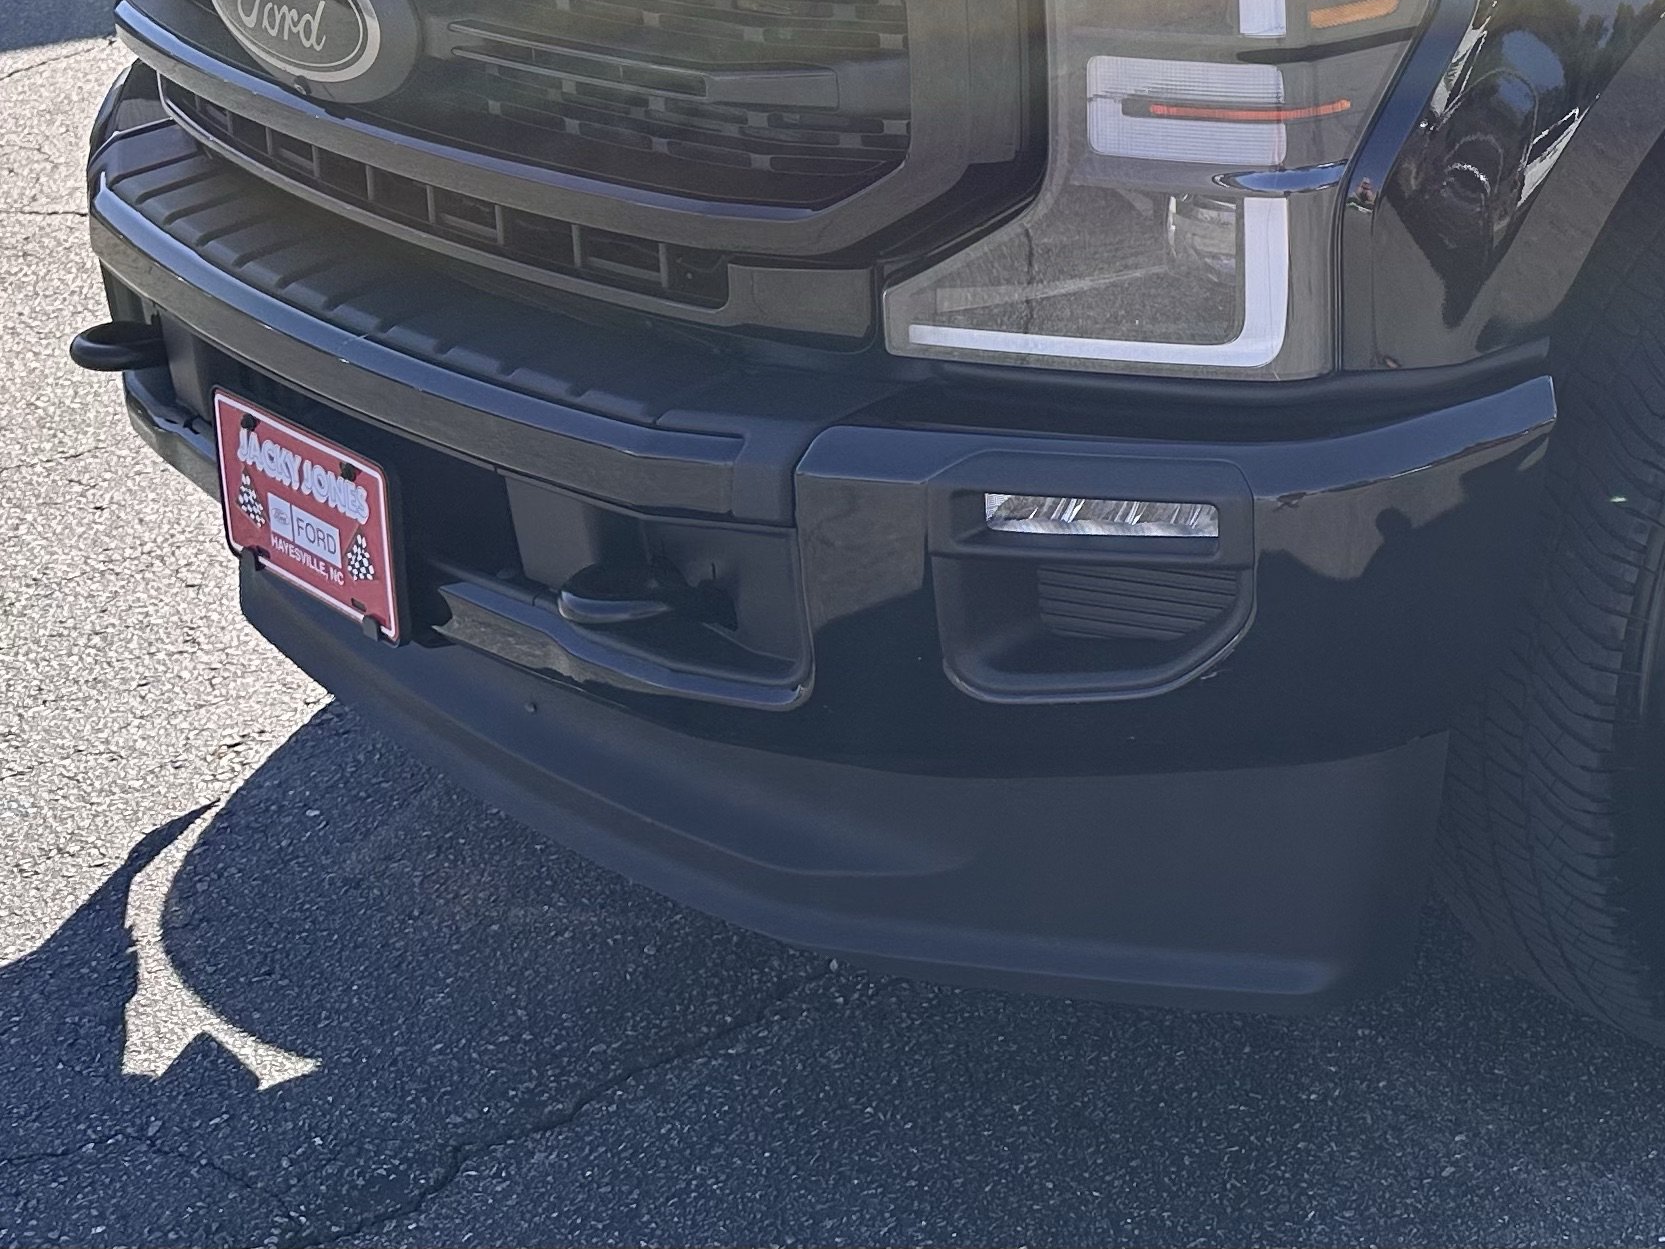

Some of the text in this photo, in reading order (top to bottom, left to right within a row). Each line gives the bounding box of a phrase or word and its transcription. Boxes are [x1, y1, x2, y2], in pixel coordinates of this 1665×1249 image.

[237, 426, 369, 525] JACKY JONES
[271, 534, 345, 586] HAYESVILLE, NC
[296, 518, 337, 555] FORD
